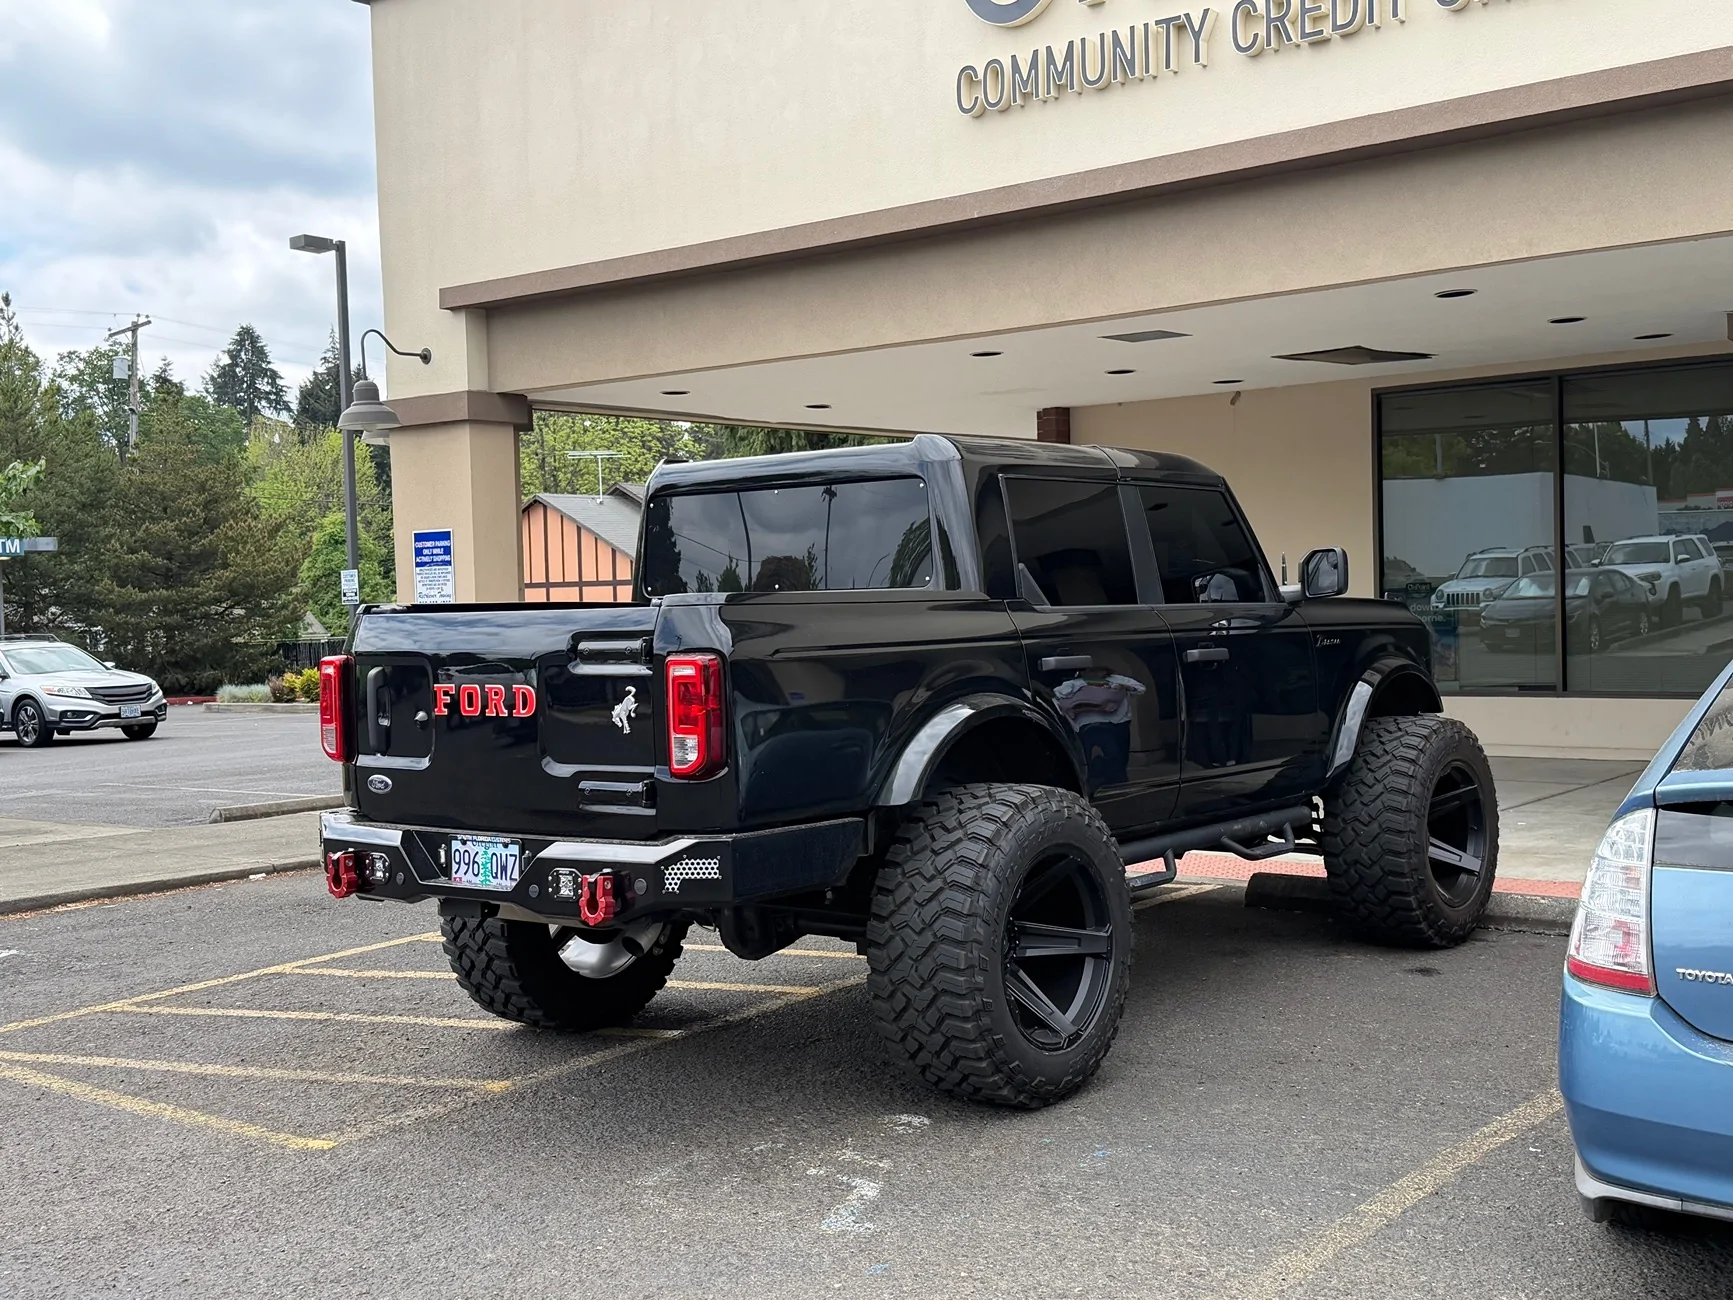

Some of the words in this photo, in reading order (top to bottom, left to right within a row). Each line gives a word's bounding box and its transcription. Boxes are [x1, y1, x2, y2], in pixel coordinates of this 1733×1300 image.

[956, 8, 1214, 116] COMMUNITY
[433, 684, 537, 717] FORD
[453, 848, 480, 878] 996
[490, 852, 518, 882] QWZ
[1675, 967, 1733, 985] TOYOTA
